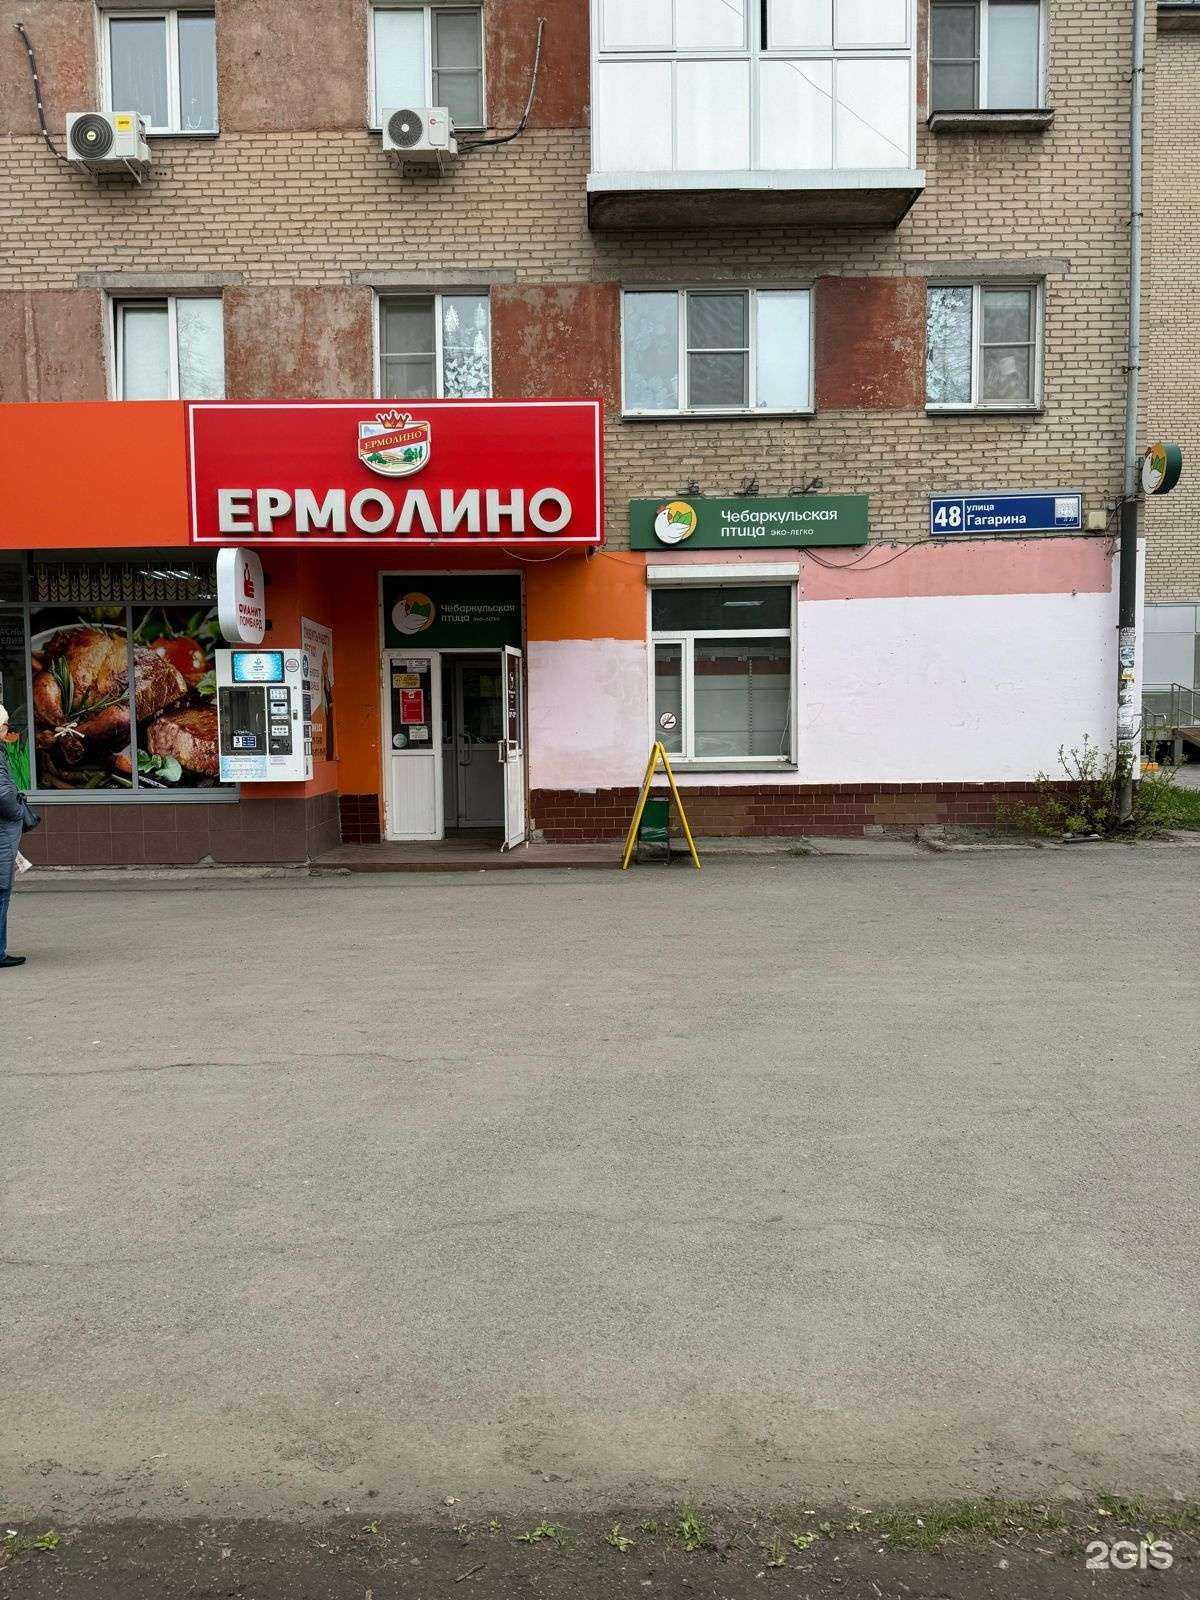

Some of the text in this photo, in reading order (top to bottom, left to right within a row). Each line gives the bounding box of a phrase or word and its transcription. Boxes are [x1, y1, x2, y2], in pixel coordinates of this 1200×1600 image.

[364, 430, 422, 450] ЕРМОЛИНО
[217, 487, 573, 534] ЕРМОЛИНО
[967, 504, 995, 513] улица
[721, 509, 839, 524] Чебаркульская
[934, 505, 961, 527] 48
[967, 514, 1027, 527] Гагарина
[721, 526, 766, 538] птица
[440, 604, 515, 615] Чебаркульская
[441, 615, 470, 623] птица
